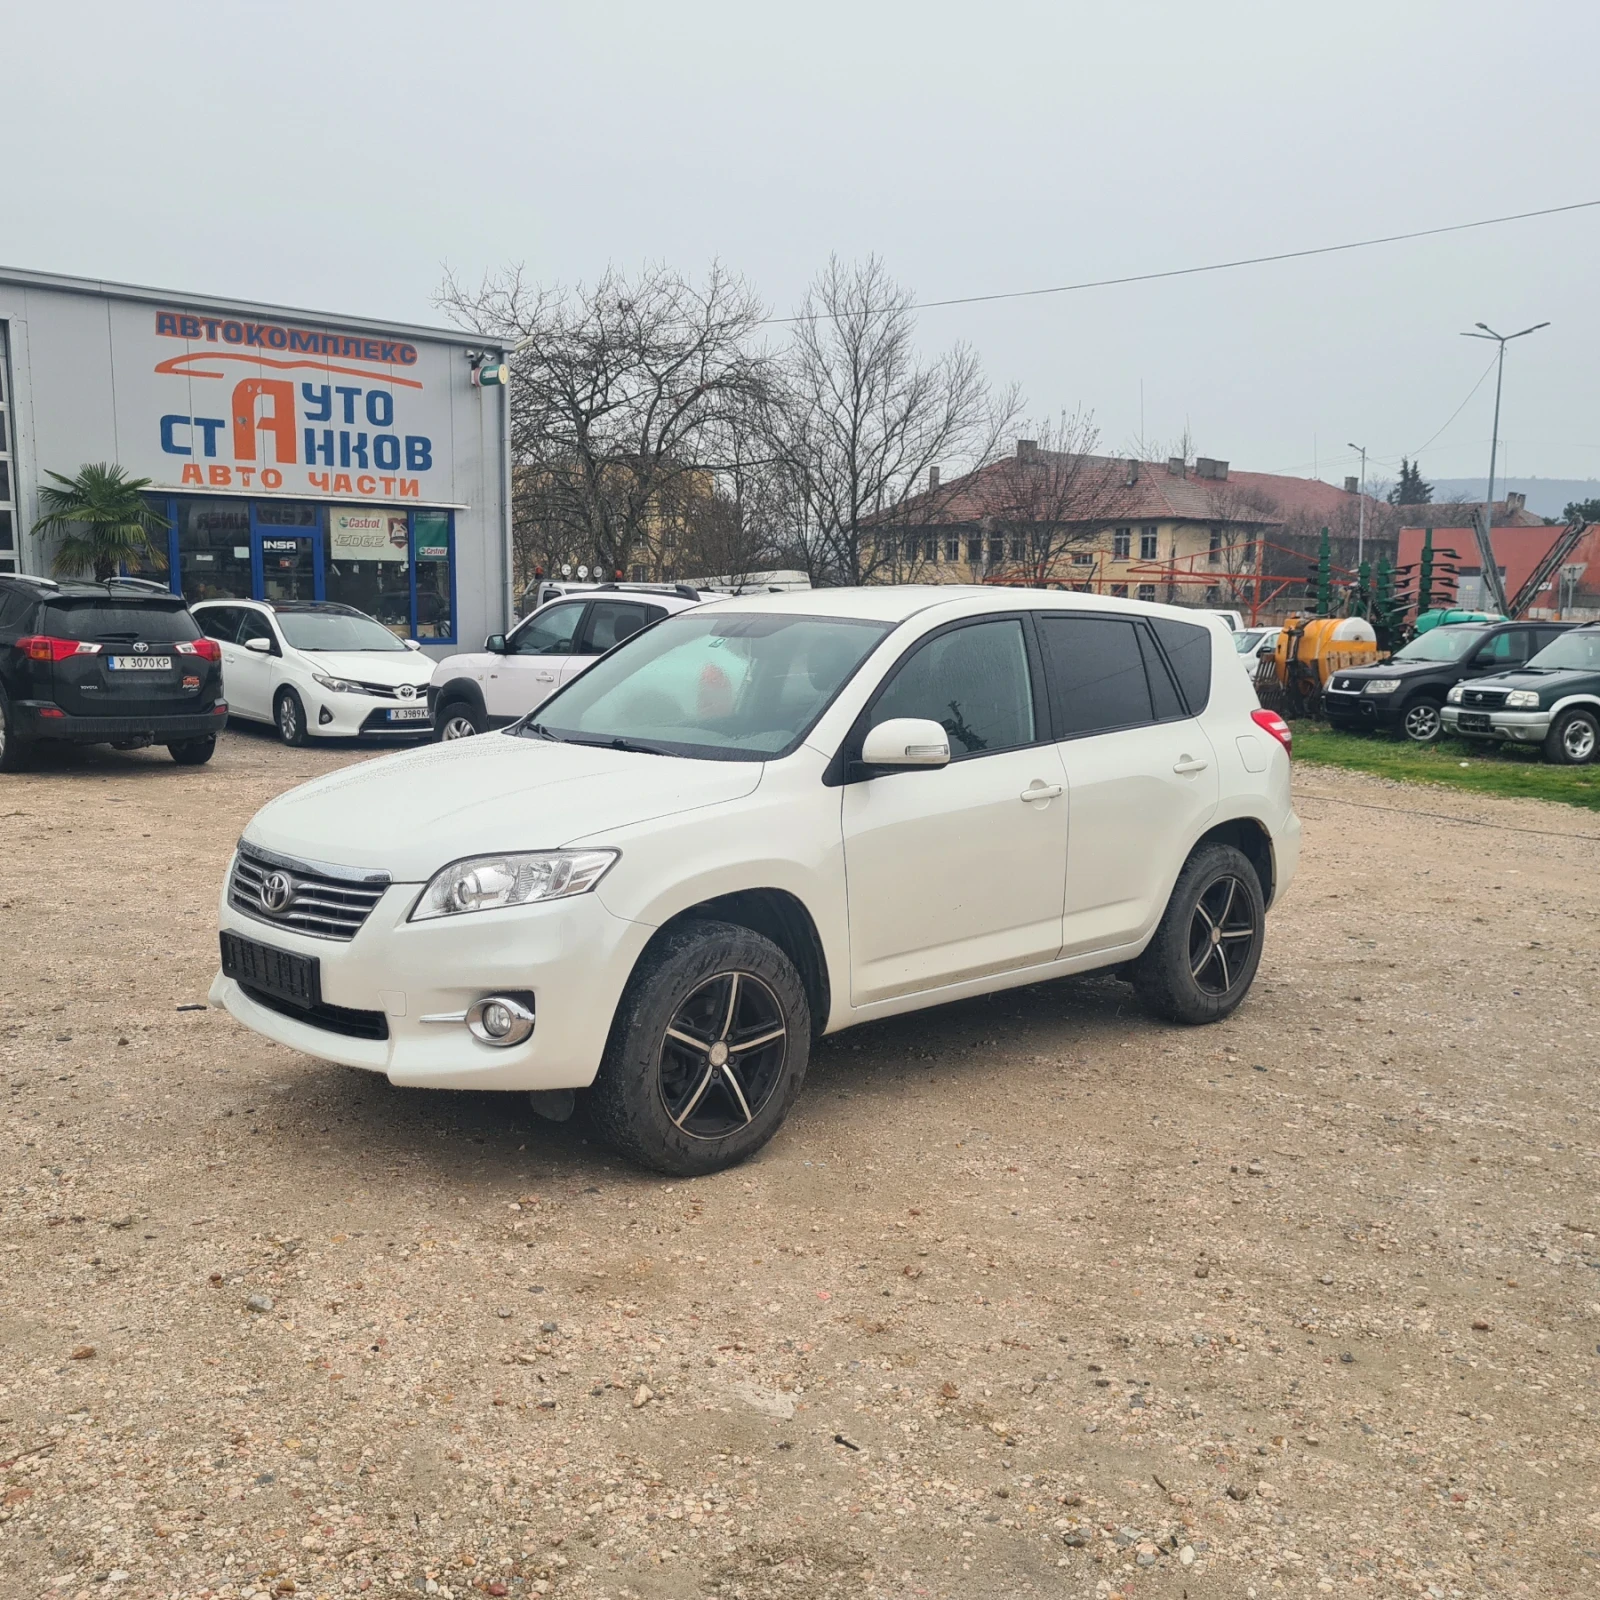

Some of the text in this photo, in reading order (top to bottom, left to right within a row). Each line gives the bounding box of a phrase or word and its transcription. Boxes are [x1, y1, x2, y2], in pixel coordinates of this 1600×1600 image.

[156, 311, 417, 365] АВТОКОМПЛЕКС
[181, 464, 419, 497] АВТО ЧАСТИ
[348, 518, 381, 529] Castrol
[263, 540, 297, 550] INSA
[335, 534, 385, 547] EDGE
